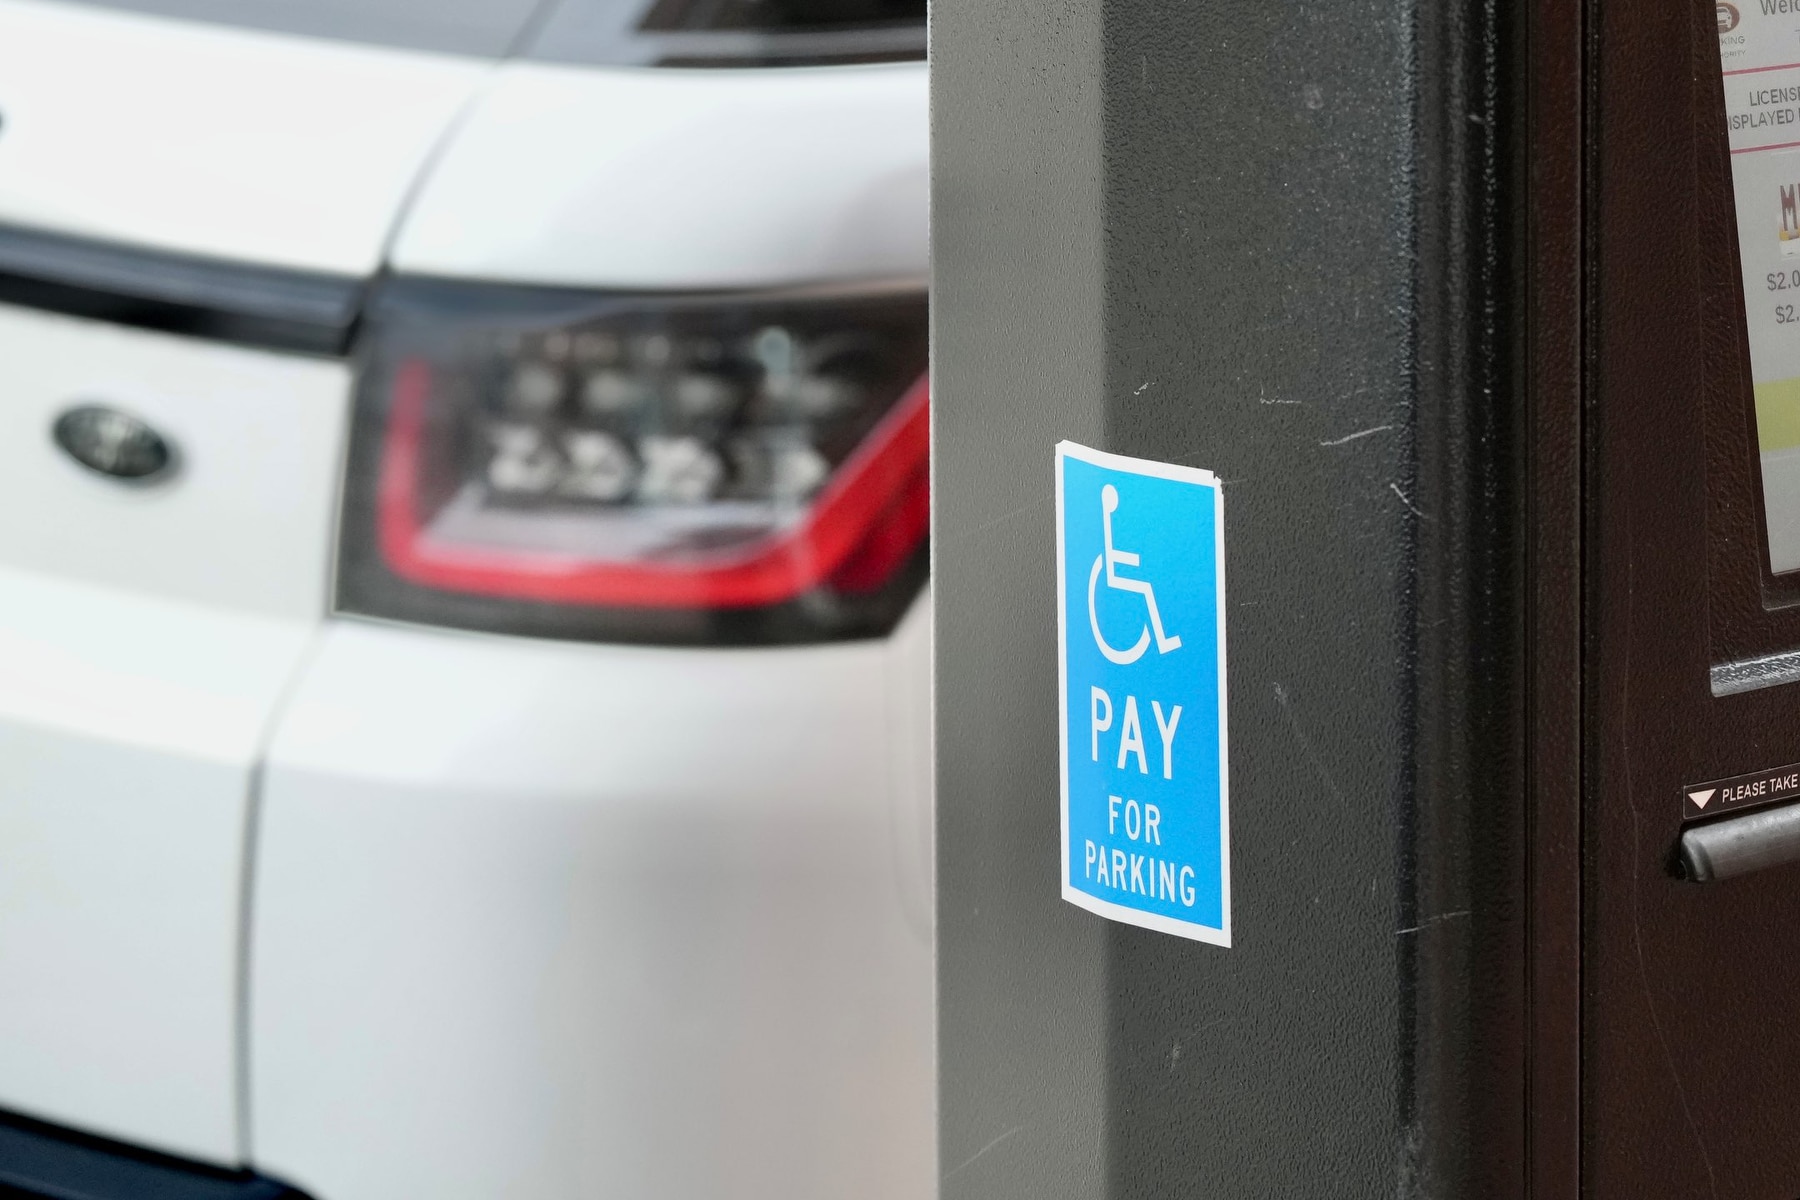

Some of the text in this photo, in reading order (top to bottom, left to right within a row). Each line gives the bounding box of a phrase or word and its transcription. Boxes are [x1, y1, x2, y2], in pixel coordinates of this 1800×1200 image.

[1090, 684, 1183, 781] PAY
[1722, 780, 1766, 803] PLEASE
[1769, 773, 1799, 793] TAKE
[1107, 794, 1162, 847] FOR
[1085, 838, 1196, 908] PARKING
